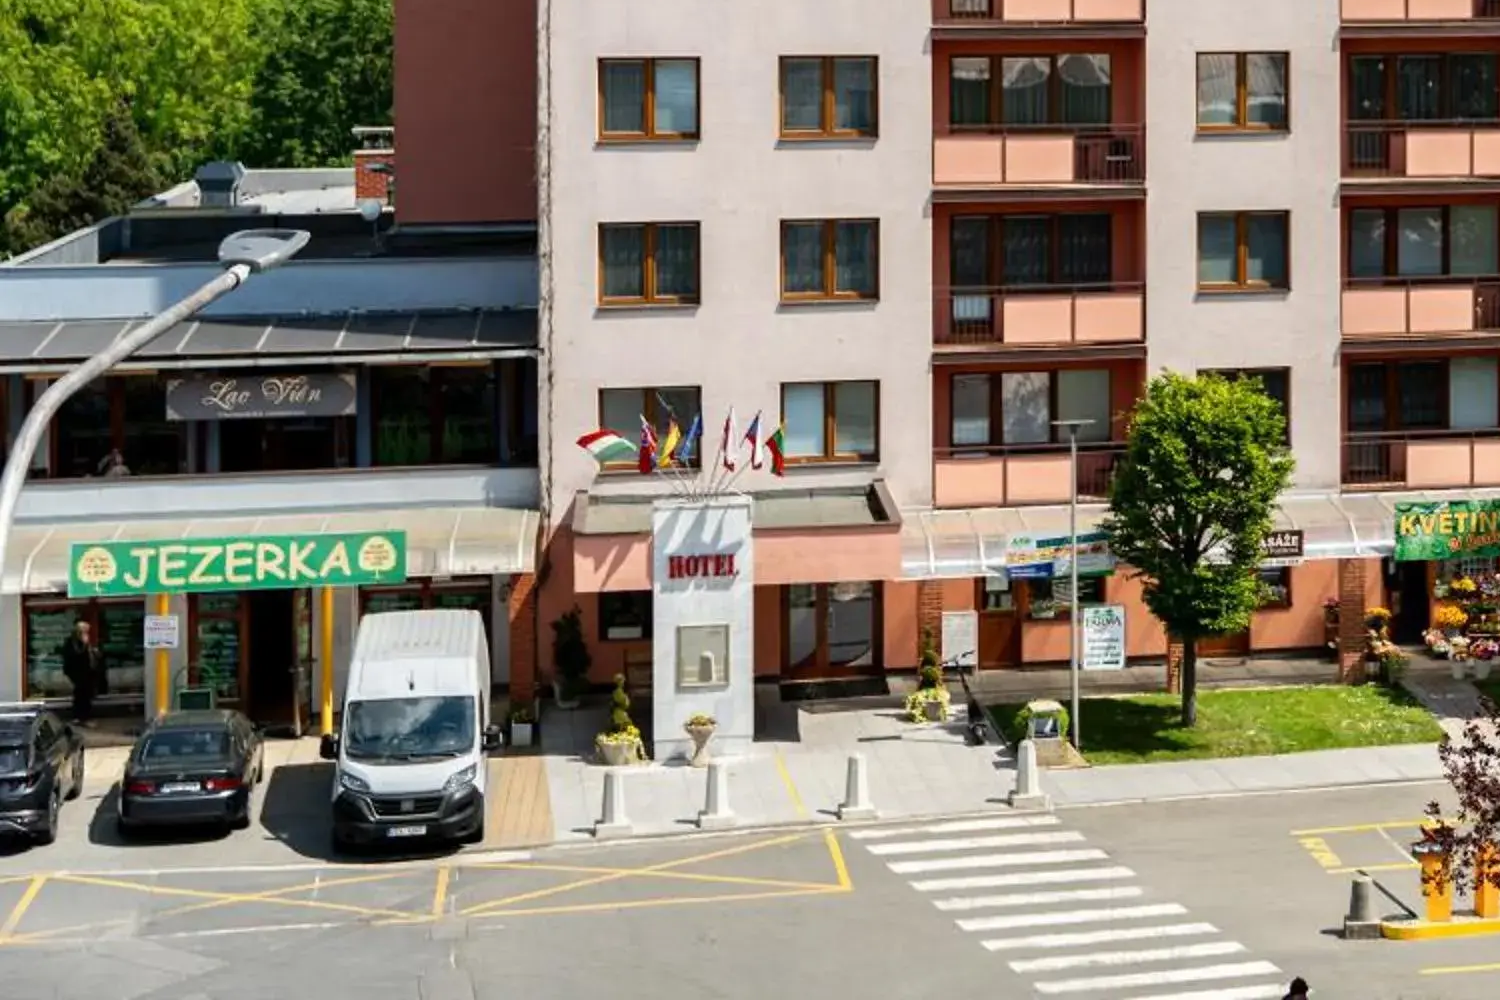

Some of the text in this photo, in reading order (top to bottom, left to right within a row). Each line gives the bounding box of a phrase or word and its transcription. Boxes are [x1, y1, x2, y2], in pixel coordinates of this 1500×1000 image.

[1259, 532, 1300, 549] ASÁŽE
[122, 541, 352, 588] JEZERKA
[668, 553, 739, 579] HOTEL
